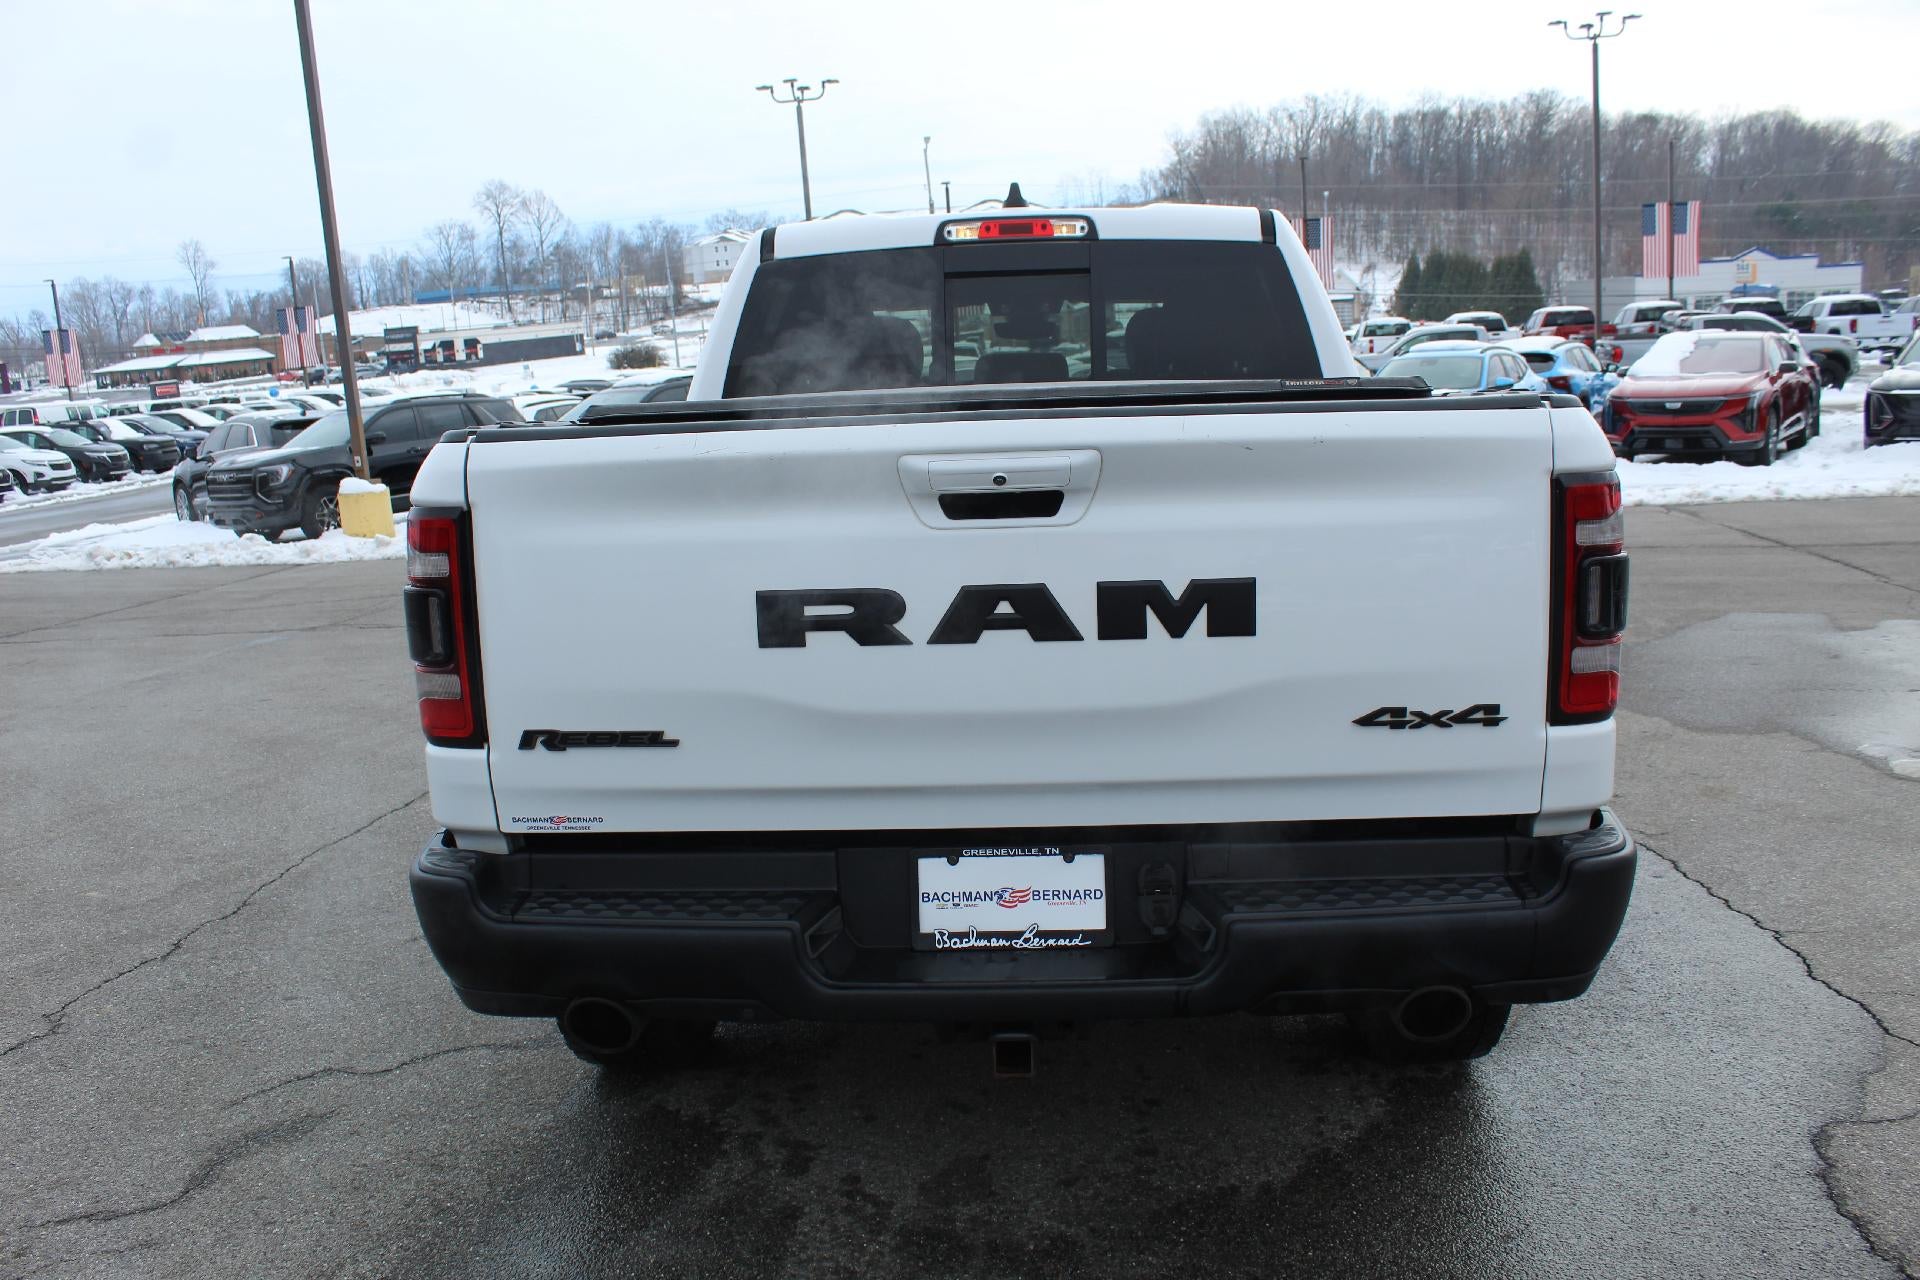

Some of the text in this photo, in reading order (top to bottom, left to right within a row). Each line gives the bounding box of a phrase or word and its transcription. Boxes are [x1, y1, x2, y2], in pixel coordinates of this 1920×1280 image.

[755, 577, 1257, 649] RAM
[1351, 703, 1509, 730] 4x4
[518, 729, 680, 751] REBEL
[511, 816, 604, 824] BACHMAN BERNARD
[962, 847, 1060, 857] GREENEVILLE, TN
[921, 889, 1104, 903] BACHMAN BERNARD
[934, 923, 1092, 949] Bachman Bernard
